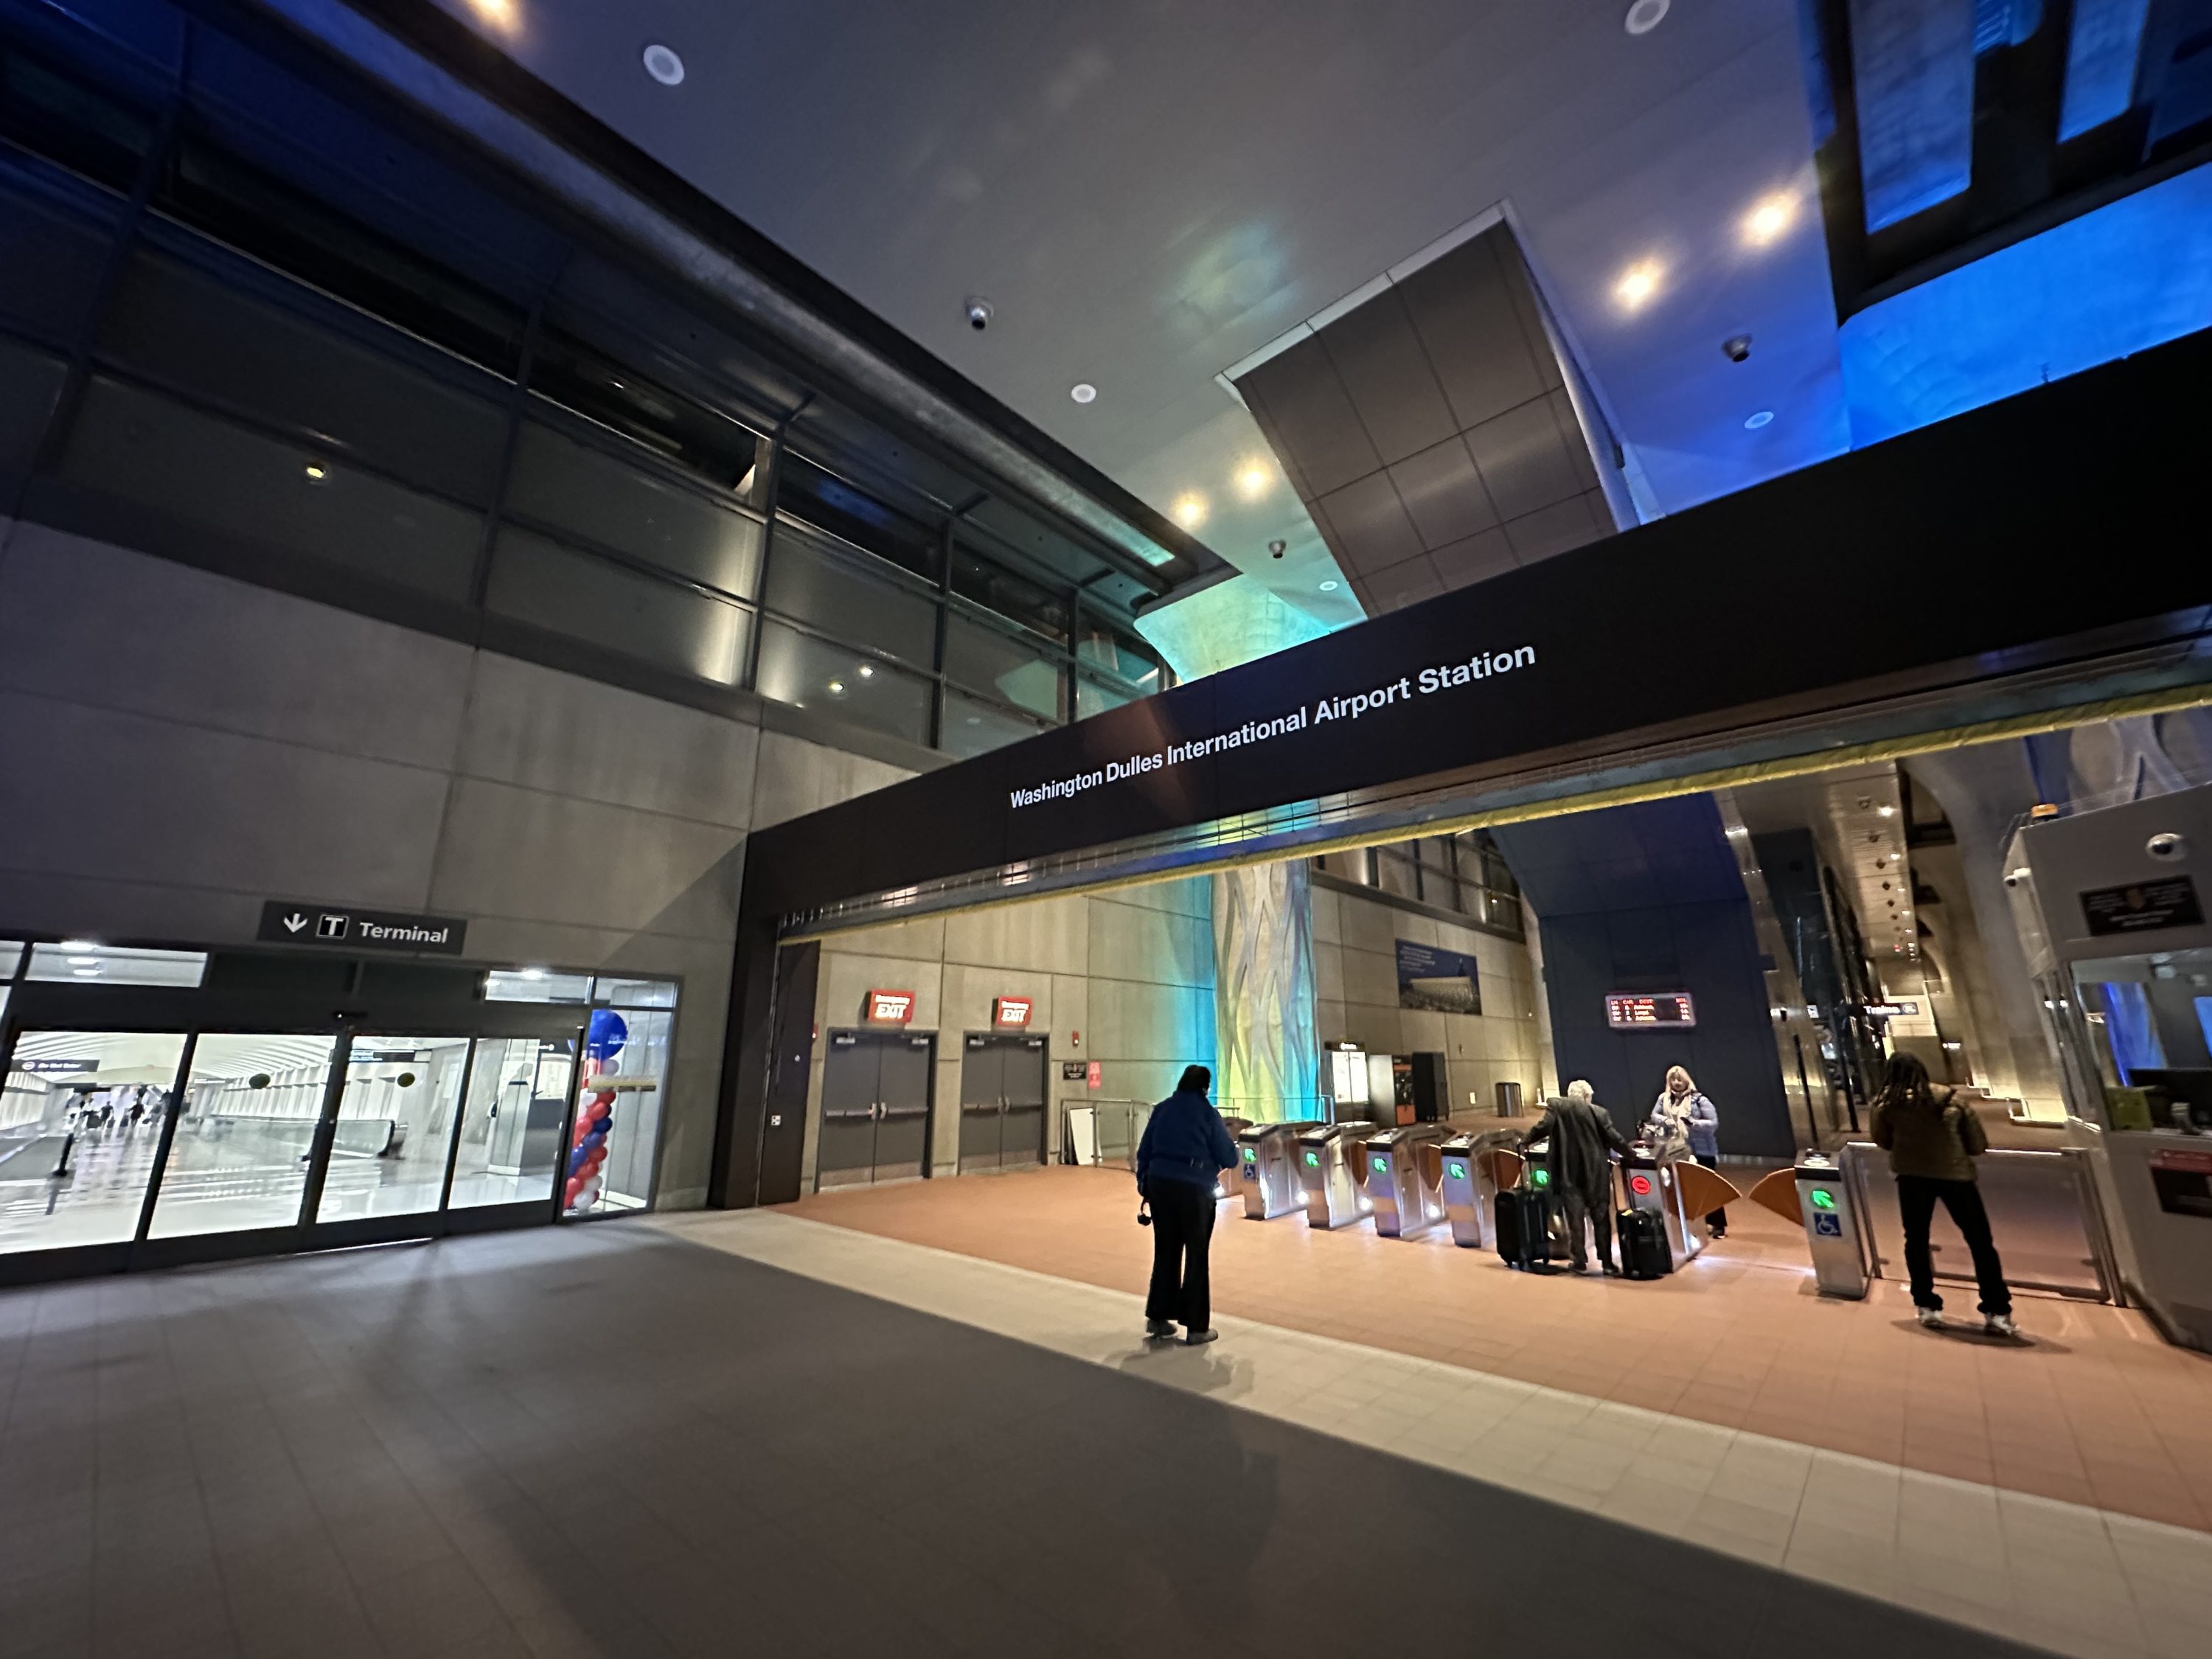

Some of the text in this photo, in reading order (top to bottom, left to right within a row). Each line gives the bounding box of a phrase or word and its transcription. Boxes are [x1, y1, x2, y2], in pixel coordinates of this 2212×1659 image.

[1010, 646, 1535, 808] Washington Dulles International Airport Station
[325, 917, 448, 944] T Terminal
[875, 1003, 907, 1019] EXIT
[1001, 1009, 1027, 1023] EXIT
[1863, 1005, 1901, 1015] Trains
